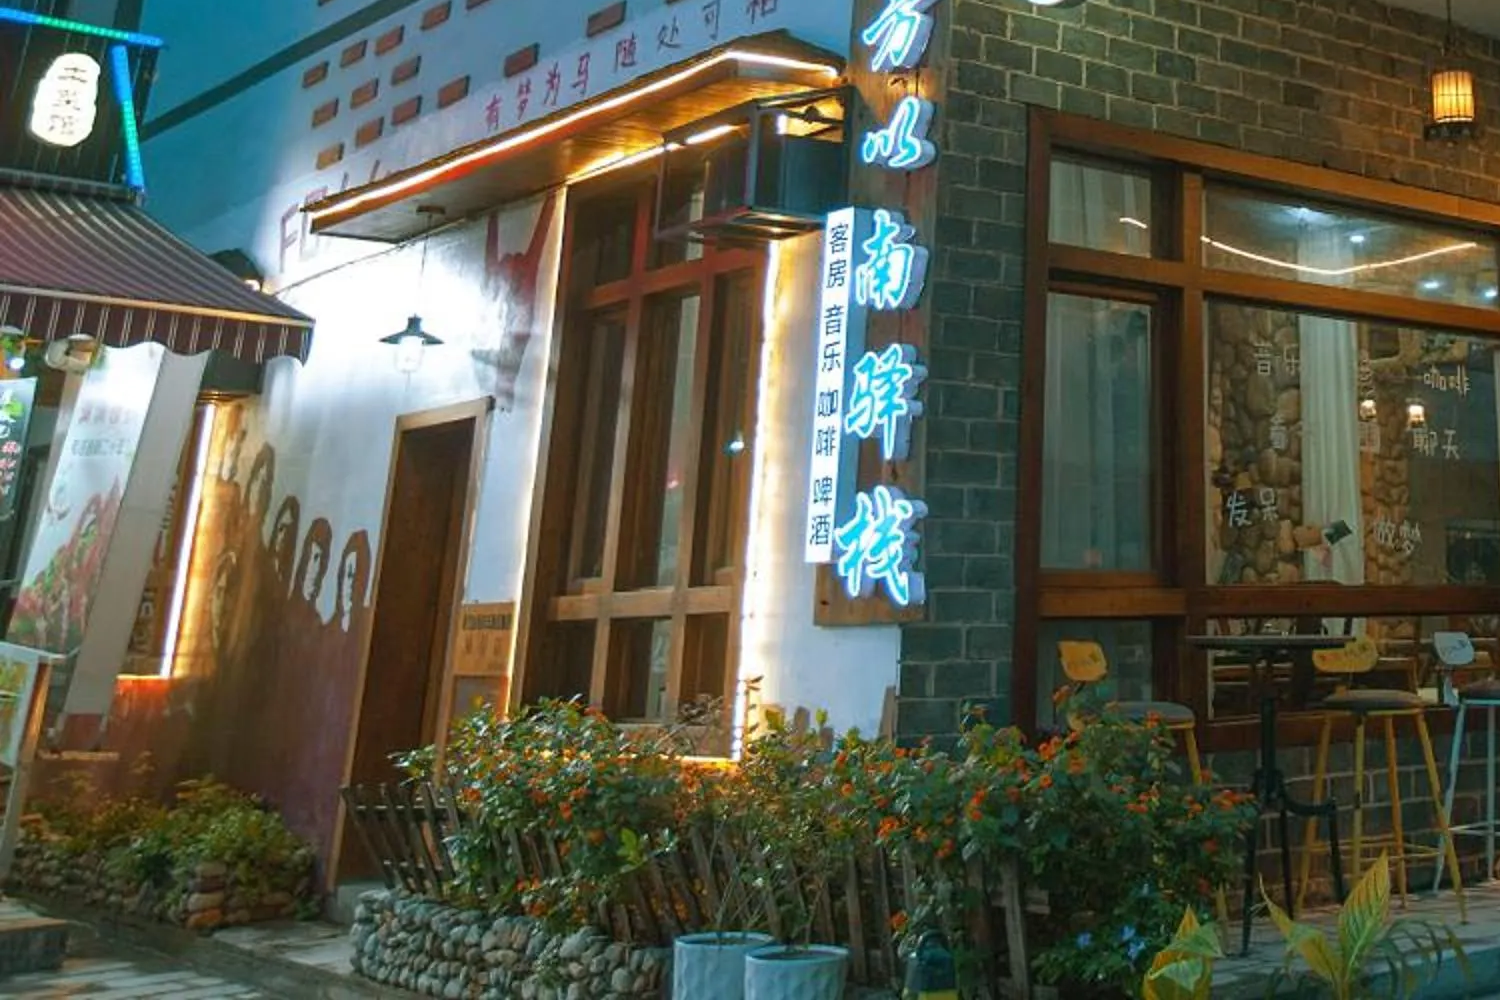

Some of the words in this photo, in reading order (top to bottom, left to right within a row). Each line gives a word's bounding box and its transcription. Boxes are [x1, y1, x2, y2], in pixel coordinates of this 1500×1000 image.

[827, 222, 849, 289] 客房
[820, 306, 844, 373] 音乐
[1424, 364, 1472, 398] 咖啡
[815, 389, 839, 456] 咖啡
[809, 478, 835, 546] 啤酒
[1226, 487, 1279, 528] 发呆
